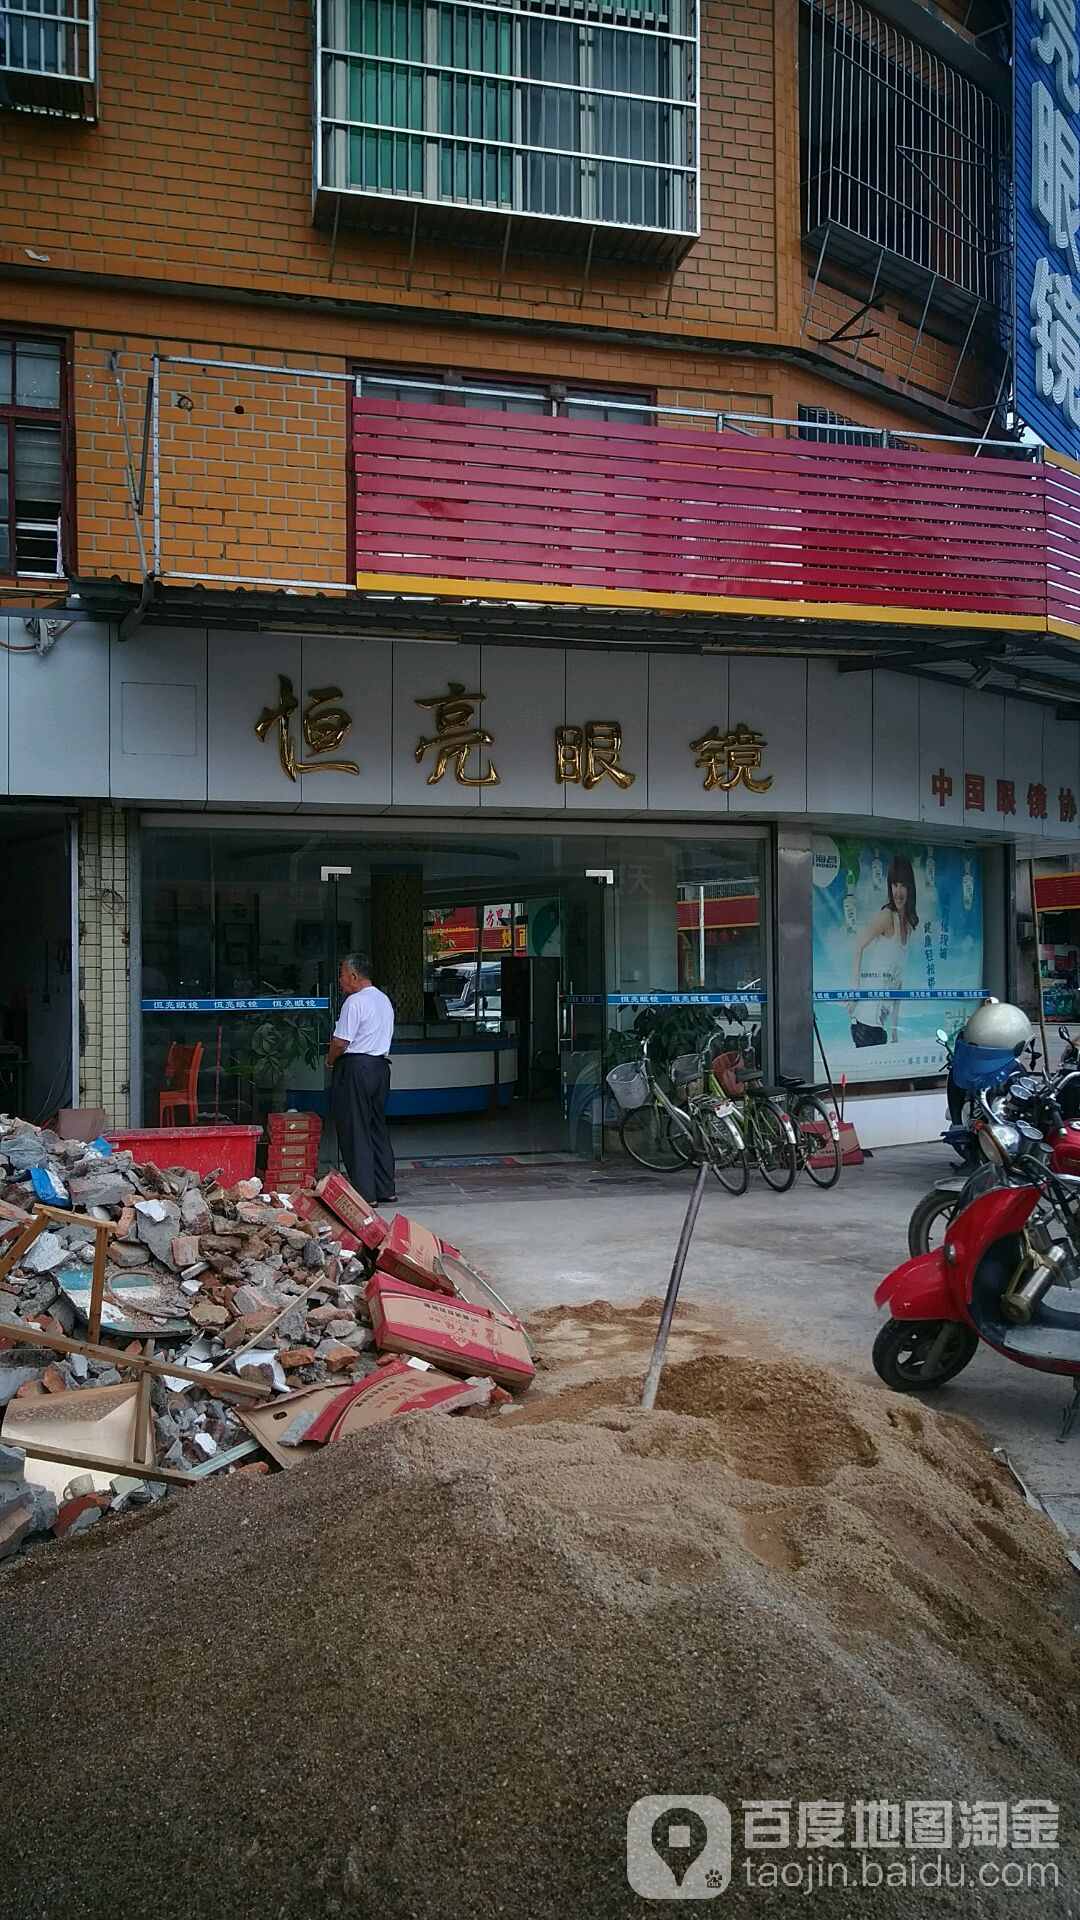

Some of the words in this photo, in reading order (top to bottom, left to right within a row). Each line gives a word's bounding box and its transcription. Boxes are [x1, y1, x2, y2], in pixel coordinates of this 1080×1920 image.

[255, 674, 774, 793] 恒亮眼镜
[932, 768, 1077, 823] 中国眼镜协
[153, 1001, 199, 1009] 恒亮眼镜
[273, 999, 316, 1007] 恒亮眼镜
[621, 995, 659, 1003] 恒亮眼镜
[671, 995, 709, 1003] 恒亮眼镜
[721, 994, 759, 1002] 恒亮眼镜
